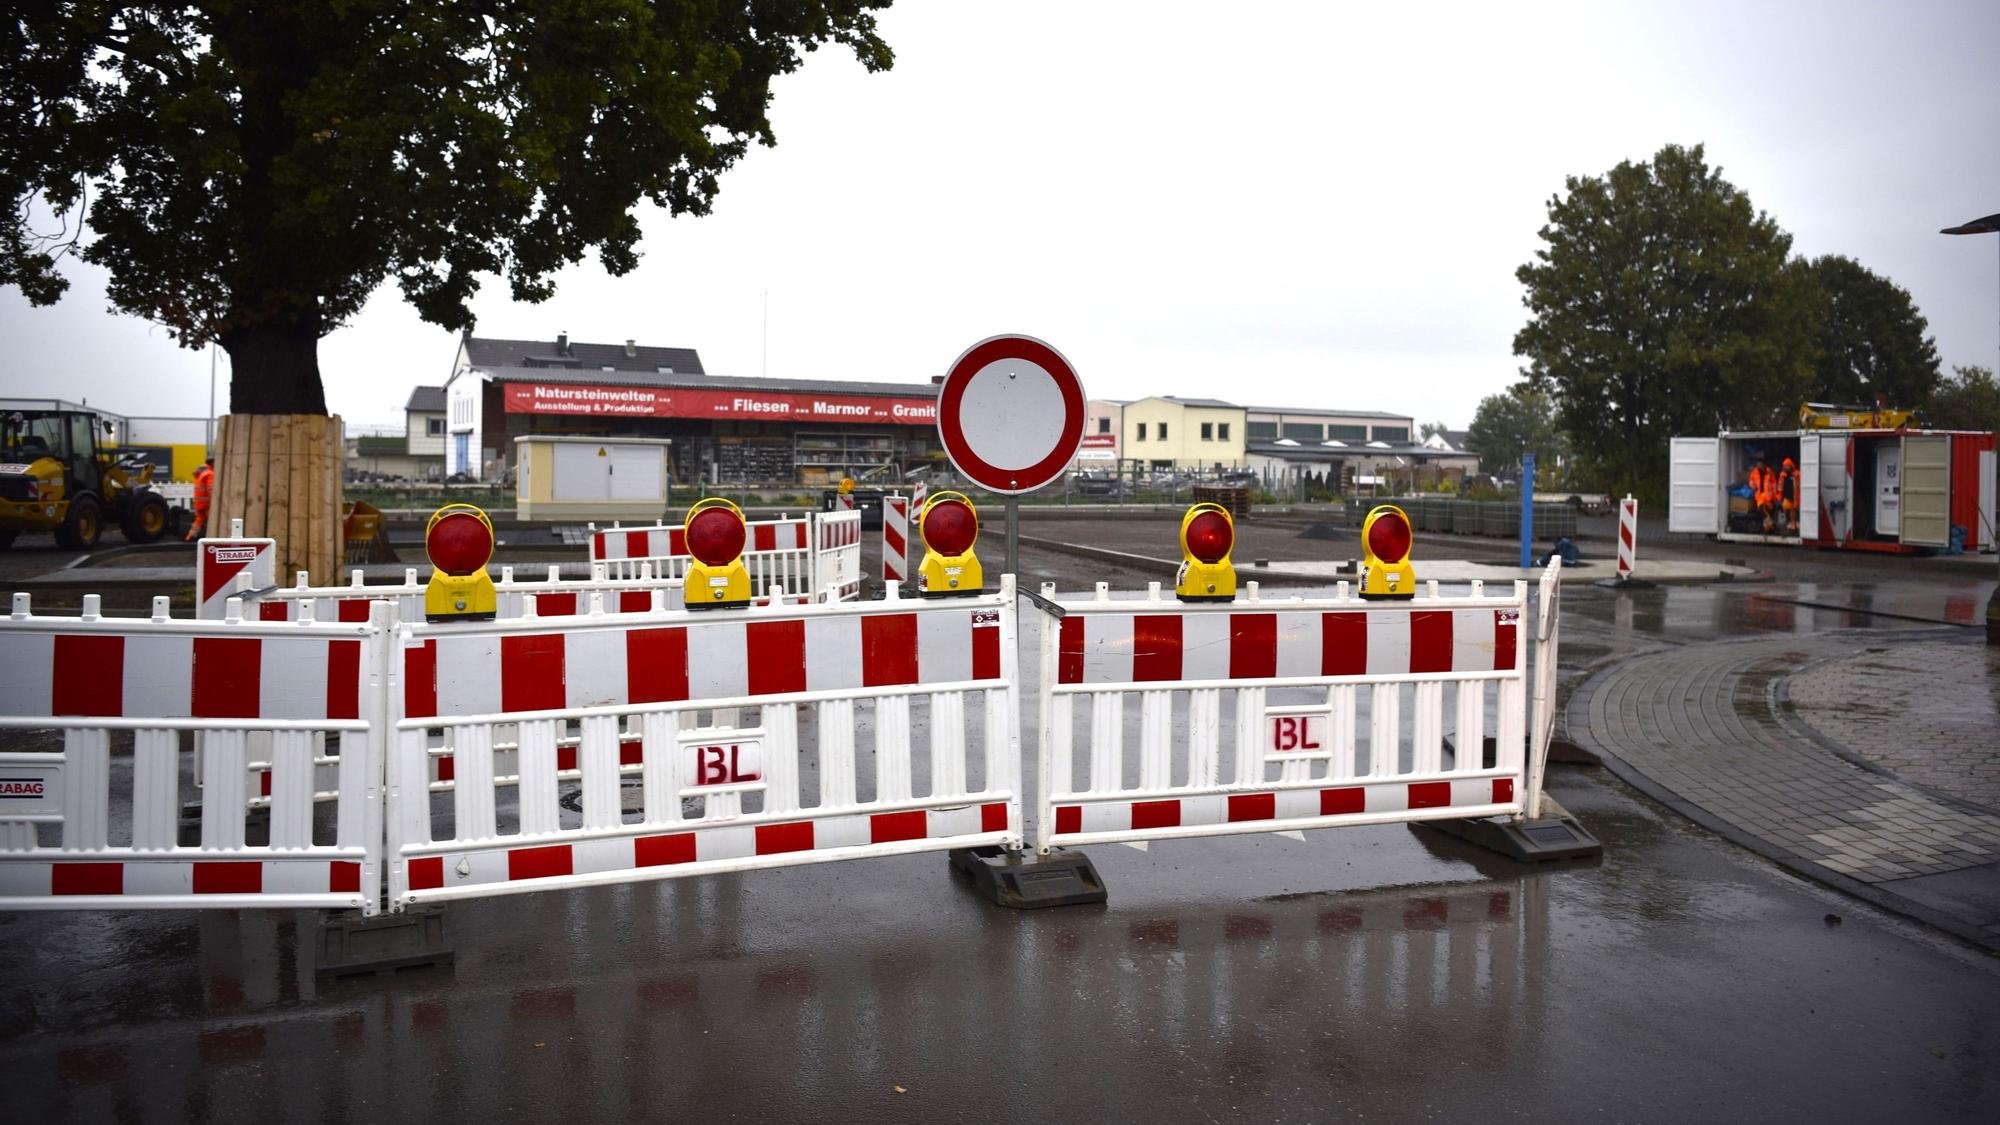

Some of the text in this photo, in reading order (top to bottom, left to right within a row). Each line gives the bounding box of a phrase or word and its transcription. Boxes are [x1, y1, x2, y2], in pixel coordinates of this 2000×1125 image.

[534, 387, 655, 402] Natursteinwelten
[534, 402, 655, 413] Ausstellung & Produktion
[733, 398, 790, 413] Fliesen
[814, 402, 871, 416] Marmor
[893, 404, 936, 417] Granit
[1274, 716, 1320, 751] BL
[697, 745, 758, 785] BL
